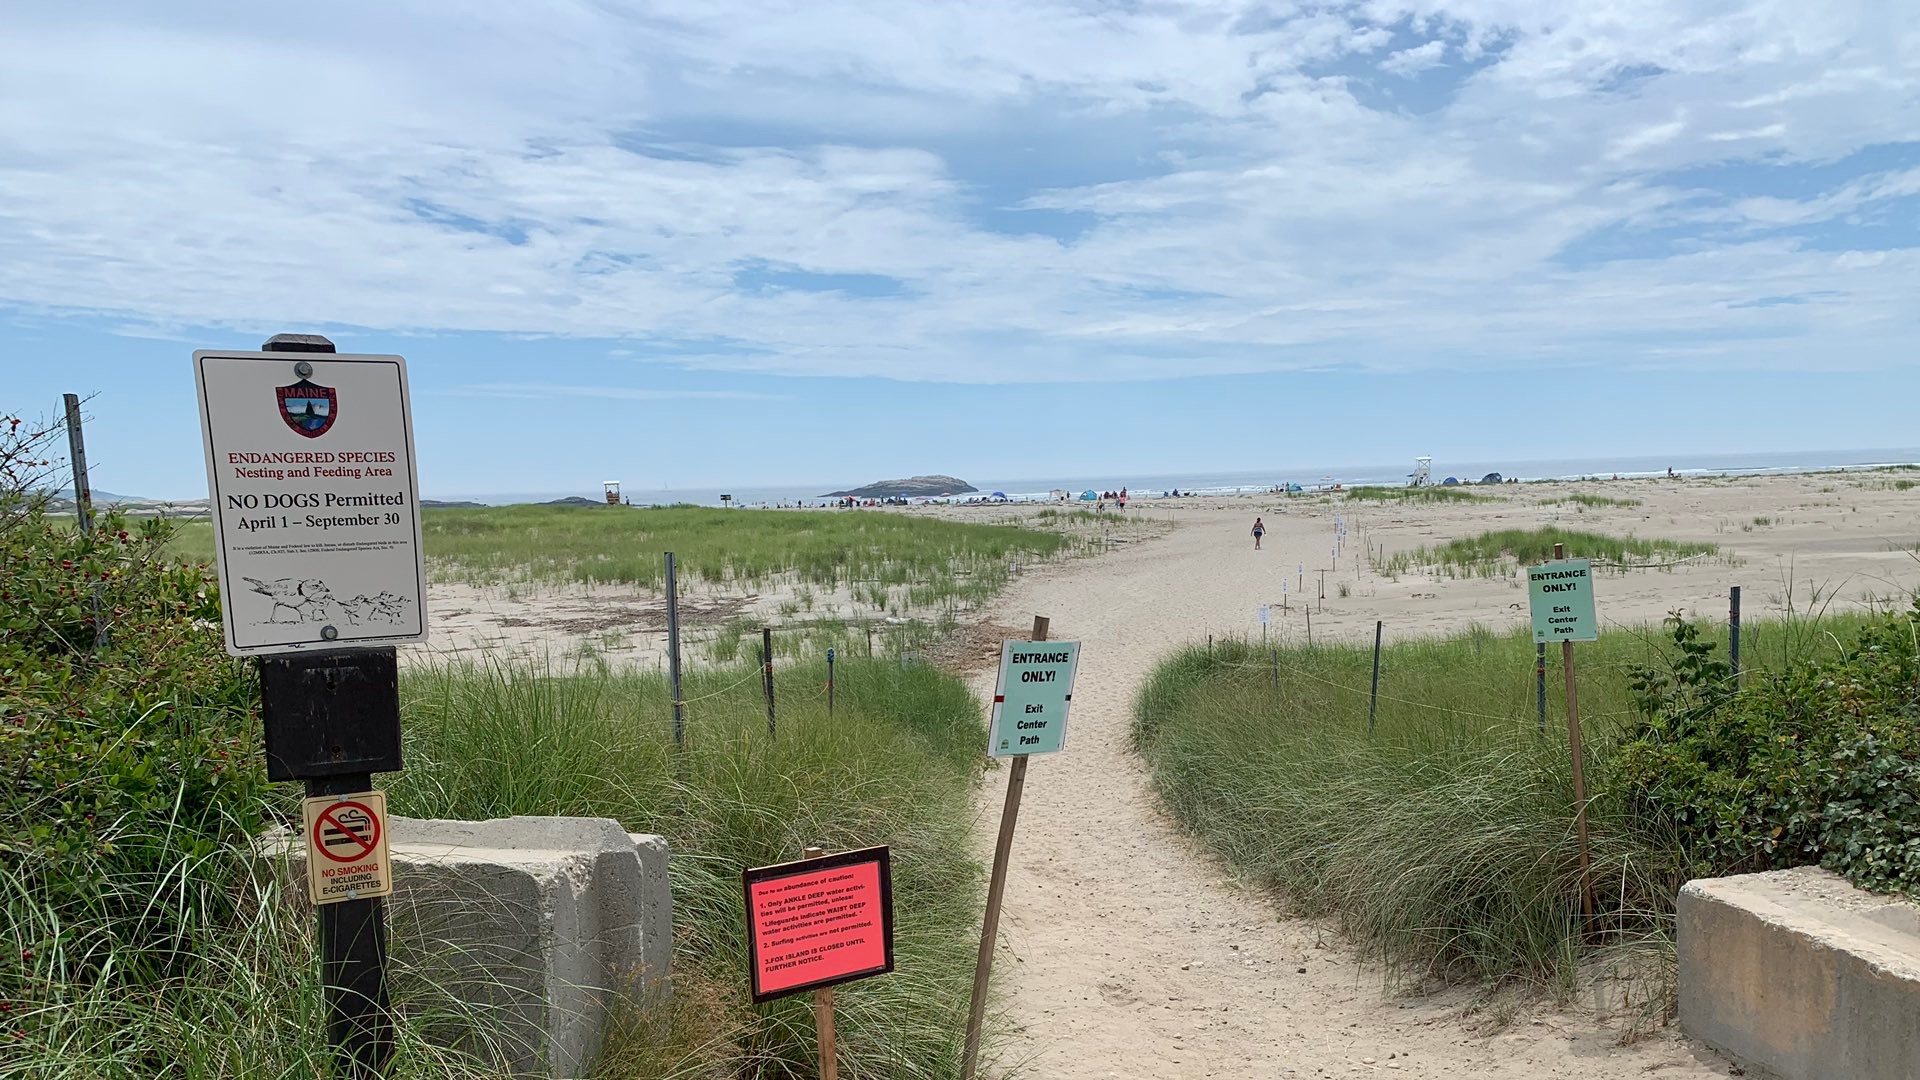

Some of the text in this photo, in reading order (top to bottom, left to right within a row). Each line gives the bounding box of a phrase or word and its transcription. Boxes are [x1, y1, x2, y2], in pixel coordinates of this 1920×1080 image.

[284, 387, 328, 398] MAINE
[228, 452, 395, 463] ENDANGERED SPECIES
[236, 466, 392, 481] Nesting and Feeding Area
[228, 492, 404, 509] NO DOGS Permitted
[238, 516, 275, 532] April
[281, 516, 288, 528] 1
[306, 514, 379, 530] September
[384, 513, 400, 525] 30
[1531, 570, 1586, 580] ENTRANCE
[1543, 583, 1576, 592] ONLY!
[1013, 653, 1068, 663] ENTRANCE
[1022, 671, 1056, 682] ONLY!
[1025, 704, 1043, 713] Exit
[1017, 720, 1047, 729] Center
[1020, 736, 1039, 745] Path
[322, 863, 378, 878] NO SMOKING
[331, 873, 372, 884] INCLUDING
[784, 880, 818, 891] abundance
[829, 874, 854, 883] caution:
[323, 880, 381, 894] E-CIGARETTES
[768, 900, 782, 908] Only
[784, 894, 806, 904] ANKLE
[846, 884, 865, 893] activi-
[798, 898, 830, 911] permitted,
[832, 895, 853, 903] unless:
[801, 910, 825, 920] indicate
[827, 905, 847, 915] WAIST
[762, 928, 780, 936] water
[783, 921, 812, 932] activities
[826, 912, 858, 924] permitted.
[772, 937, 794, 947] Surfing
[796, 933, 818, 941] activities
[841, 921, 873, 933] permitted.
[765, 956, 783, 965] 3.FOX
[786, 950, 809, 960] ISLAND
[819, 942, 844, 952] CLOSED
[765, 955, 824, 973] FURTHER NOTICE.
